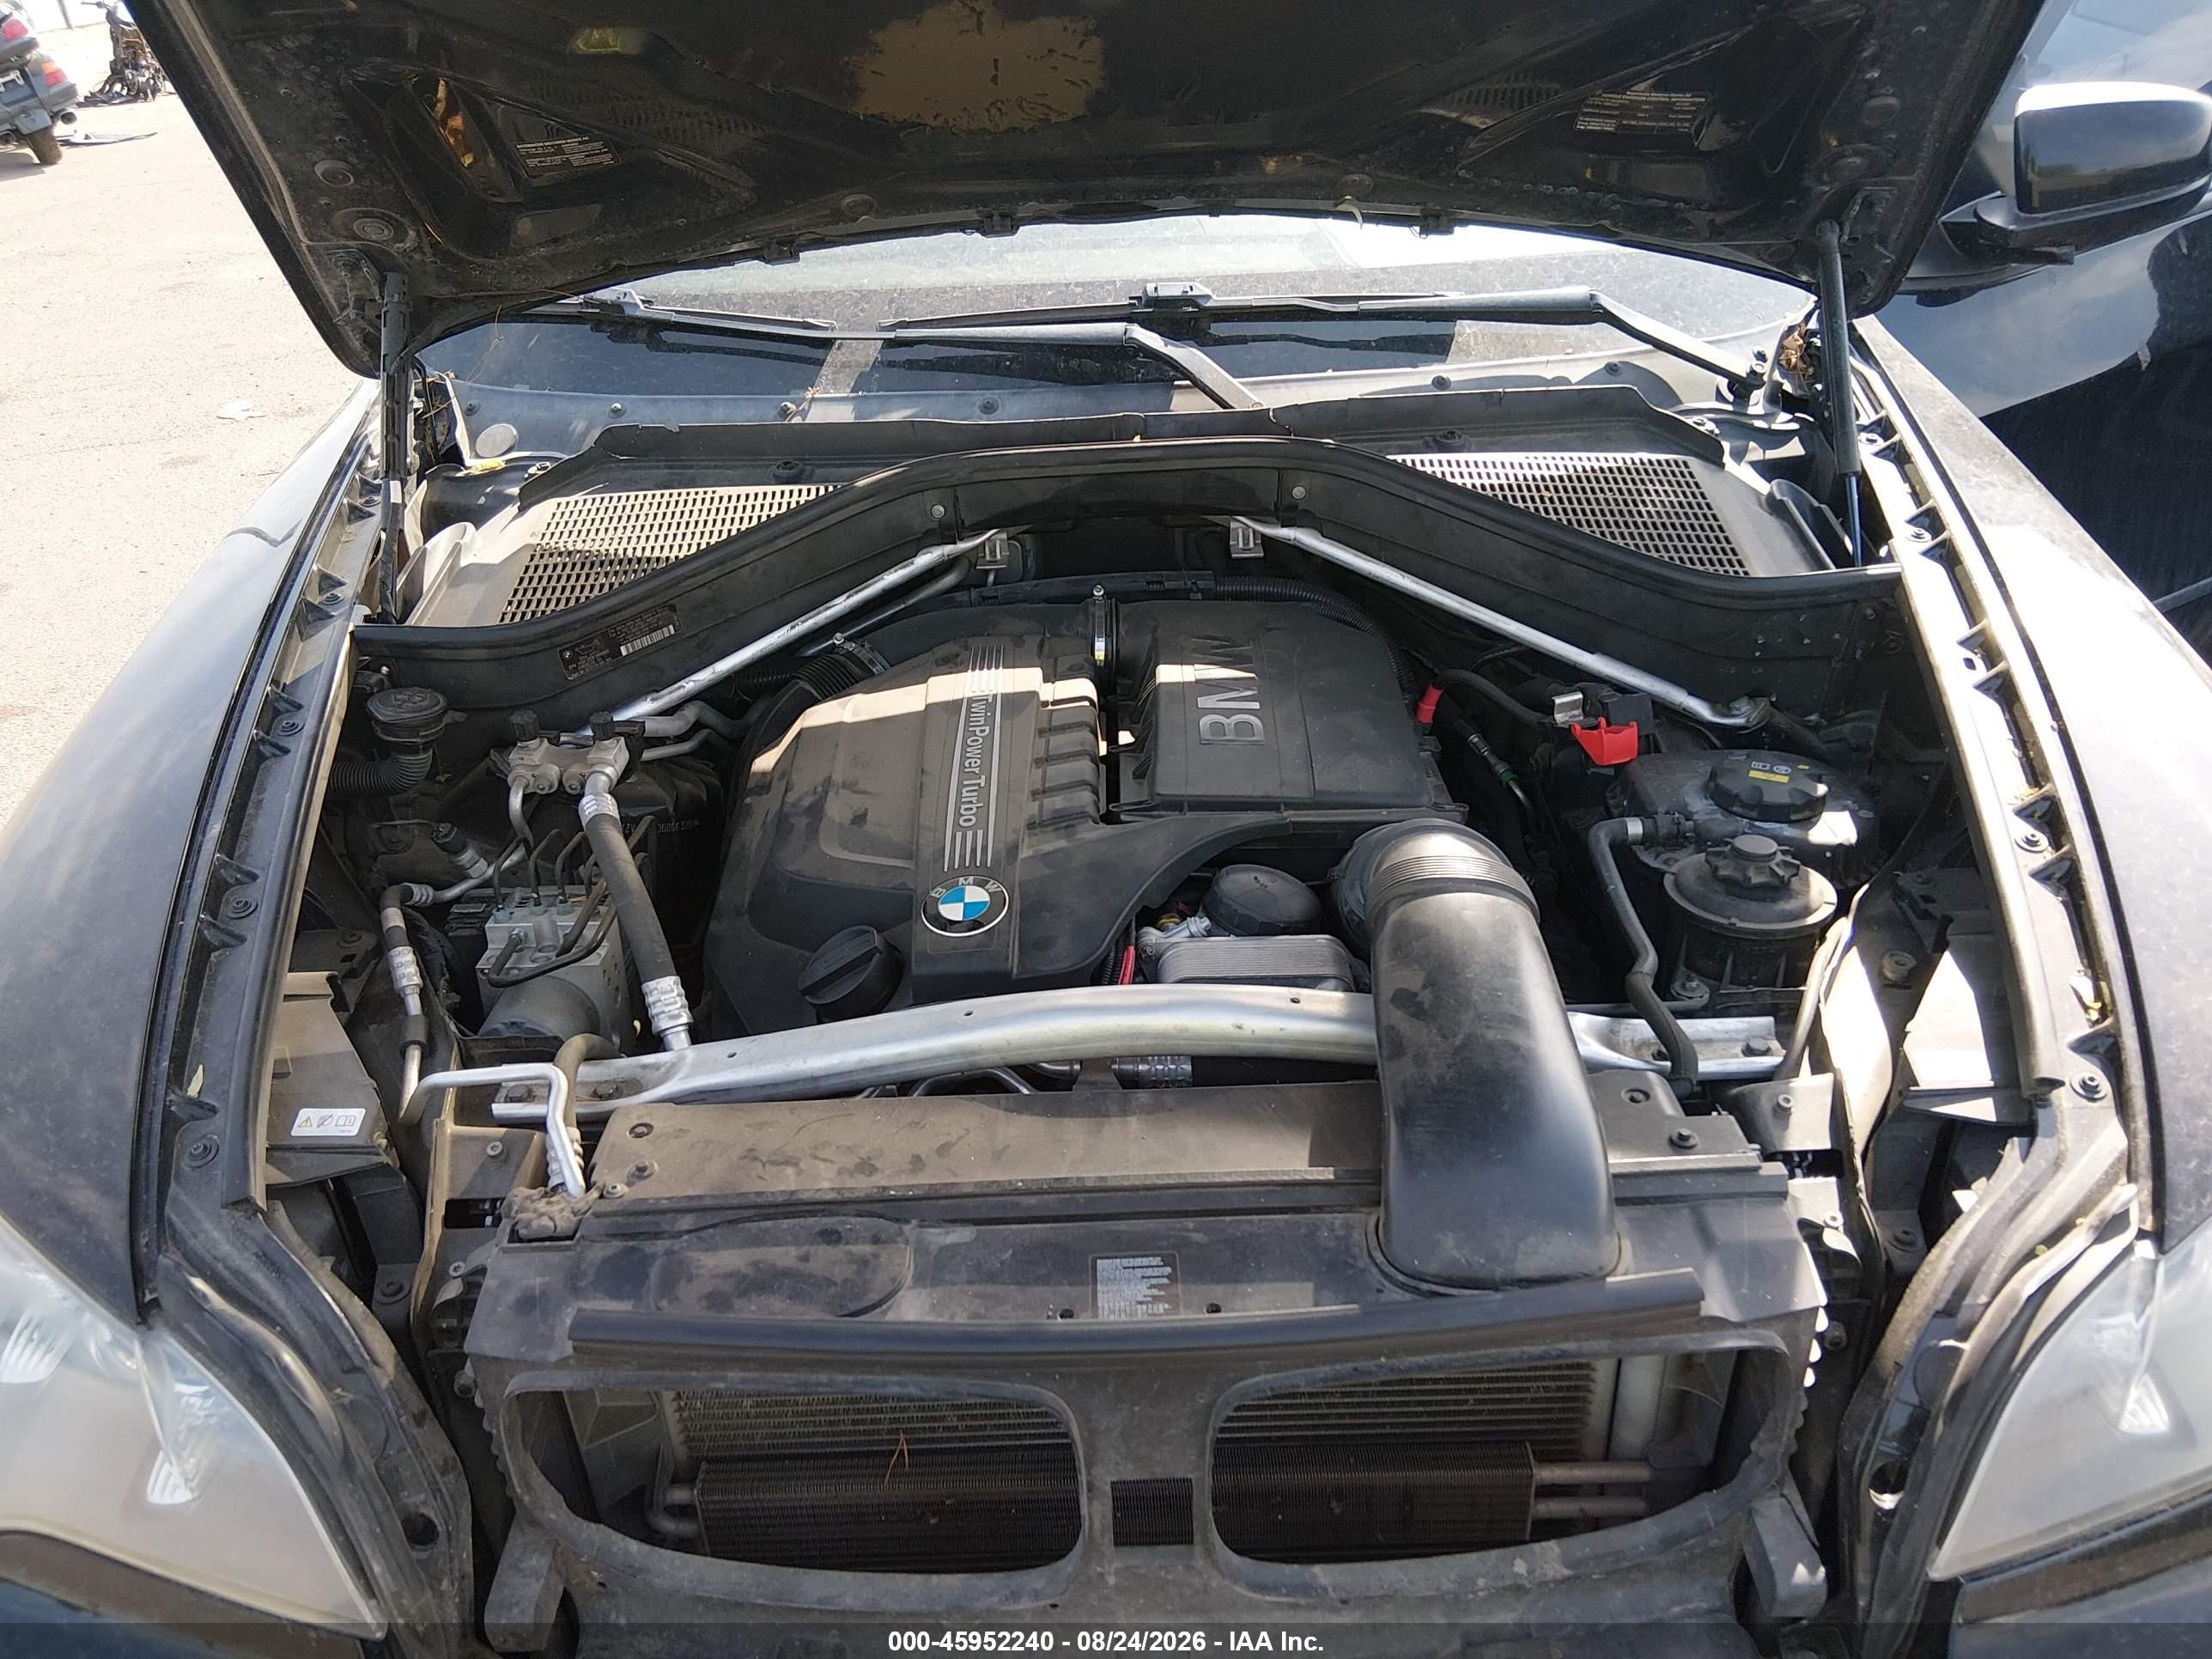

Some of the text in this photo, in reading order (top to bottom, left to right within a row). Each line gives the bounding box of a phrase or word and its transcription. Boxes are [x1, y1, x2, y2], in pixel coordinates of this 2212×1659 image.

[1193, 635, 1265, 745] BMW
[958, 694, 994, 828] TwinPower Turbo
[931, 877, 1002, 898] BMW
